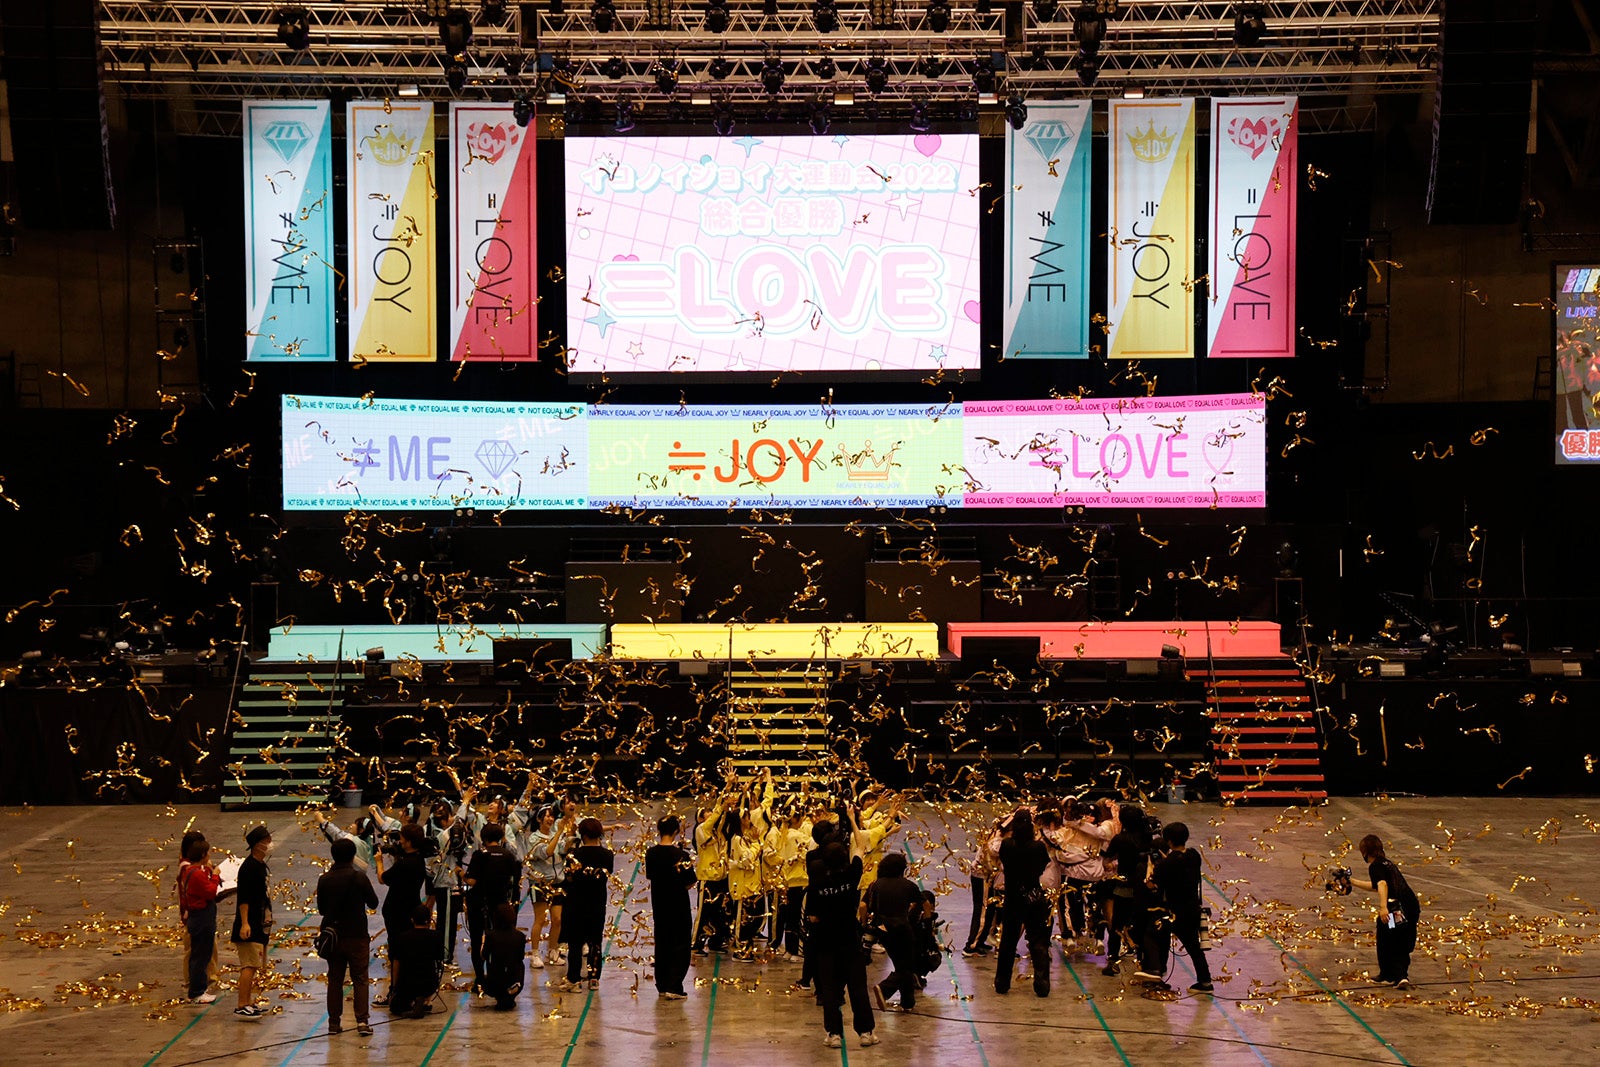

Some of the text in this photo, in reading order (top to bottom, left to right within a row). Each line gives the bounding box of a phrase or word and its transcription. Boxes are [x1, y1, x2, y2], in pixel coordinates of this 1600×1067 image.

[703, 199, 842, 231] 総合優勝
[1565, 306, 1598, 318] LIVE
[381, 404, 398, 412] EQUAL
[471, 406, 484, 414] NOT
[485, 406, 506, 414] EQUAL
[527, 407, 541, 415] NOT
[987, 405, 1004, 413] LOVE
[1194, 400, 1211, 408] EQUAL
